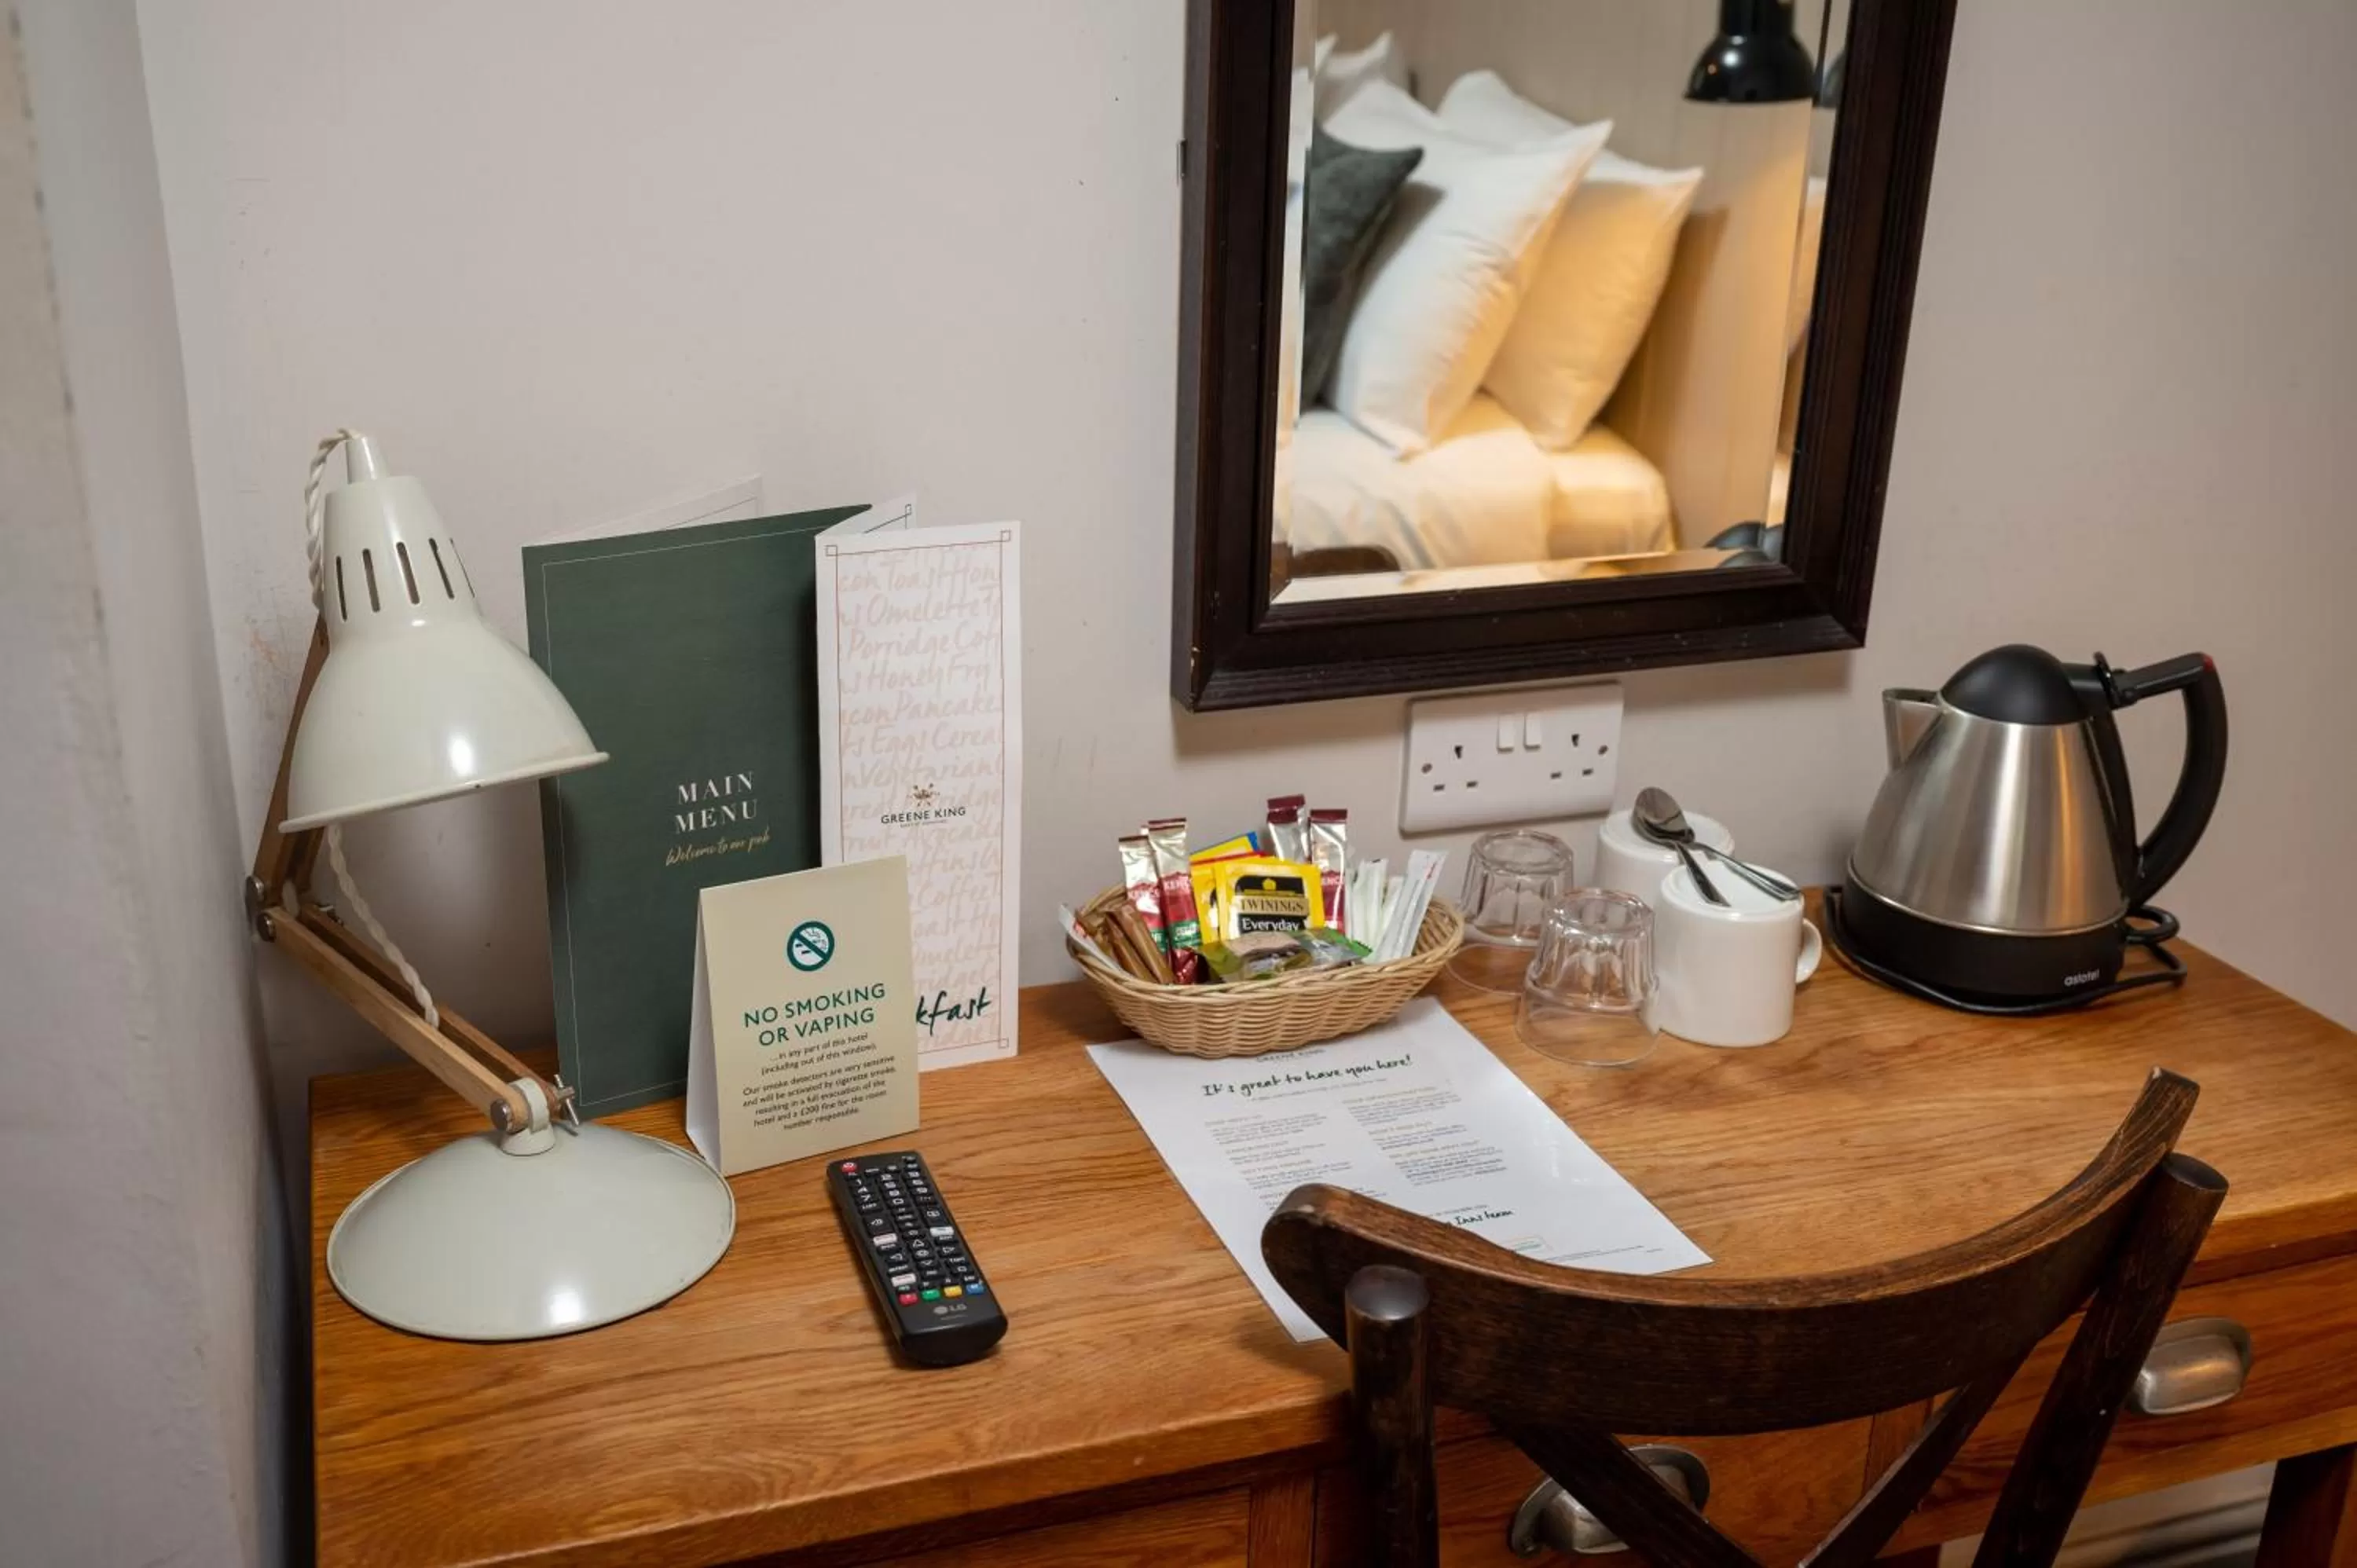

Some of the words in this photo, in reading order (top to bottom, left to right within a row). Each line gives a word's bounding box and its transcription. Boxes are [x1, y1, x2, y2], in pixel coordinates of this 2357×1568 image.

[679, 771, 754, 805] MAIN
[676, 799, 757, 834] MENU
[881, 810, 930, 824] GREENE
[934, 807, 966, 818] KING
[1241, 898, 1303, 912] TWININGS
[1242, 917, 1300, 932] Everyday
[744, 1006, 778, 1028] NO
[785, 984, 886, 1019] SMOKING
[759, 1028, 790, 1046] OR
[795, 1007, 875, 1038] VAPING
[1241, 1074, 1281, 1097] great
[1285, 1073, 1302, 1085] to
[1305, 1069, 1341, 1081] have
[1345, 1063, 1375, 1079] you
[1376, 1053, 1411, 1070] here!
[1484, 1209, 1515, 1221] team
[948, 1303, 968, 1312] LG
